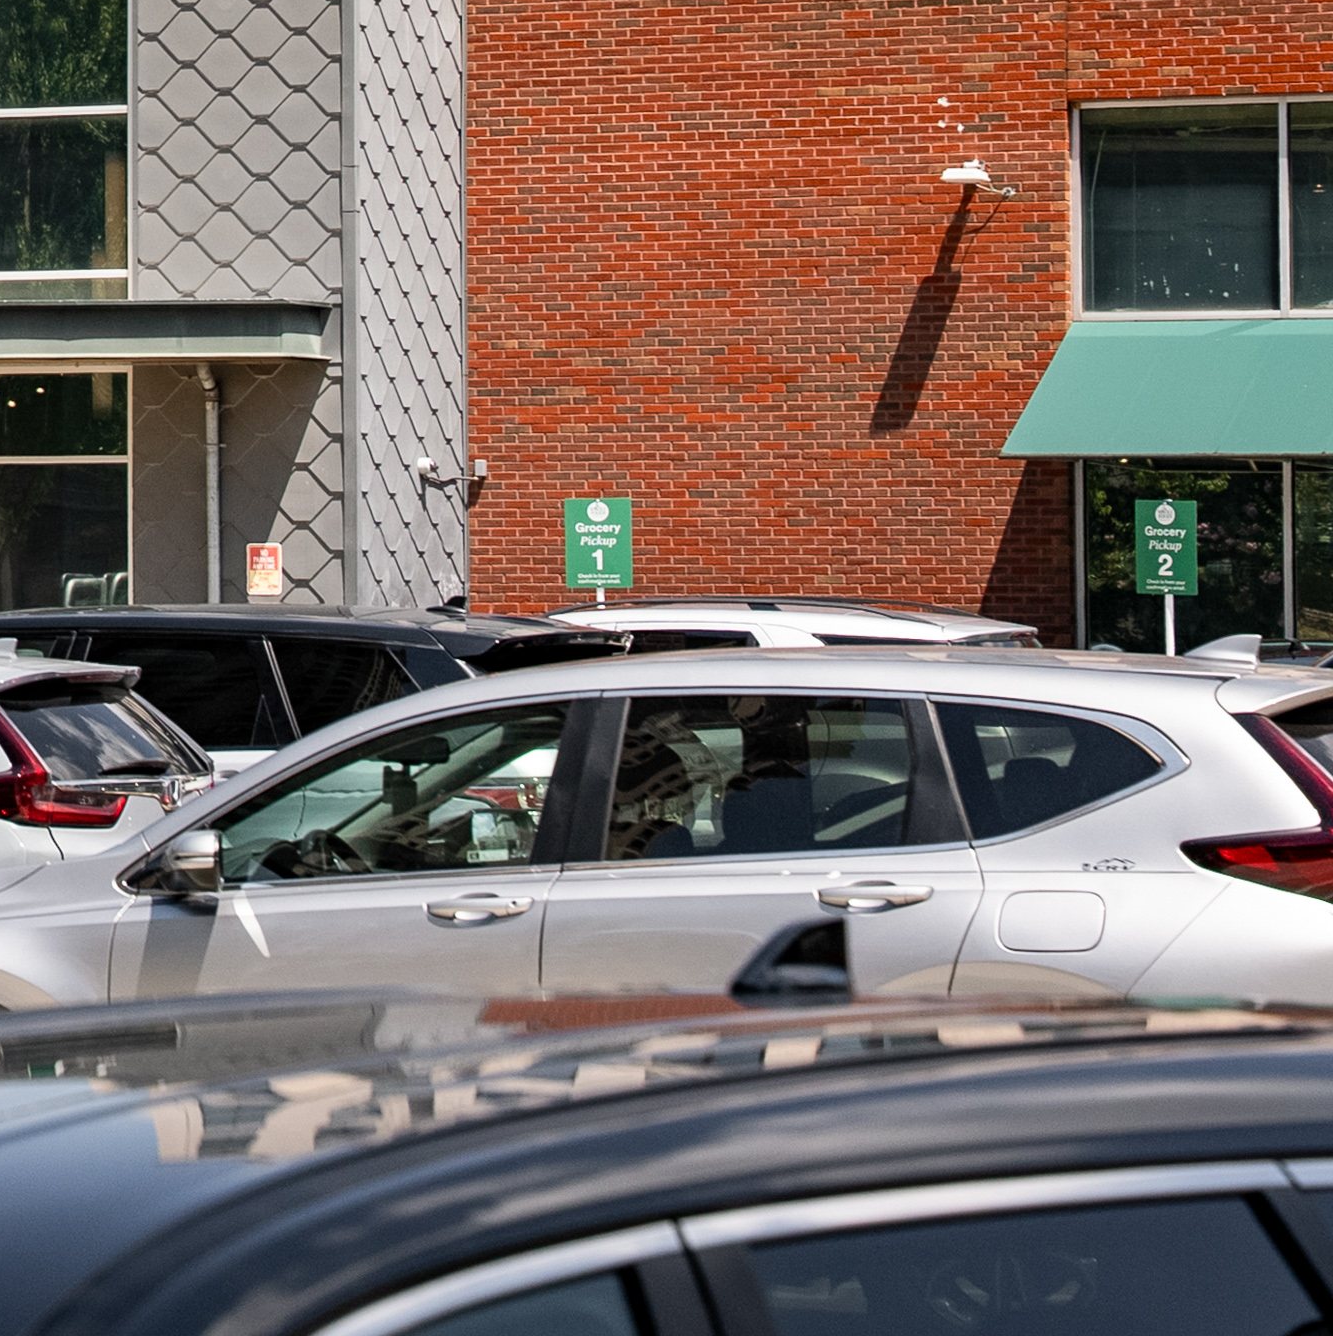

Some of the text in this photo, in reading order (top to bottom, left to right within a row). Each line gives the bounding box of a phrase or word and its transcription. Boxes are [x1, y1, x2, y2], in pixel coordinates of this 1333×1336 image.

[574, 522, 621, 535] Grocery
[1144, 525, 1186, 539] Grocery
[580, 535, 617, 548] Pickup
[1148, 539, 1183, 553] Pickup
[591, 548, 603, 571] 1
[1158, 553, 1173, 576] 2
